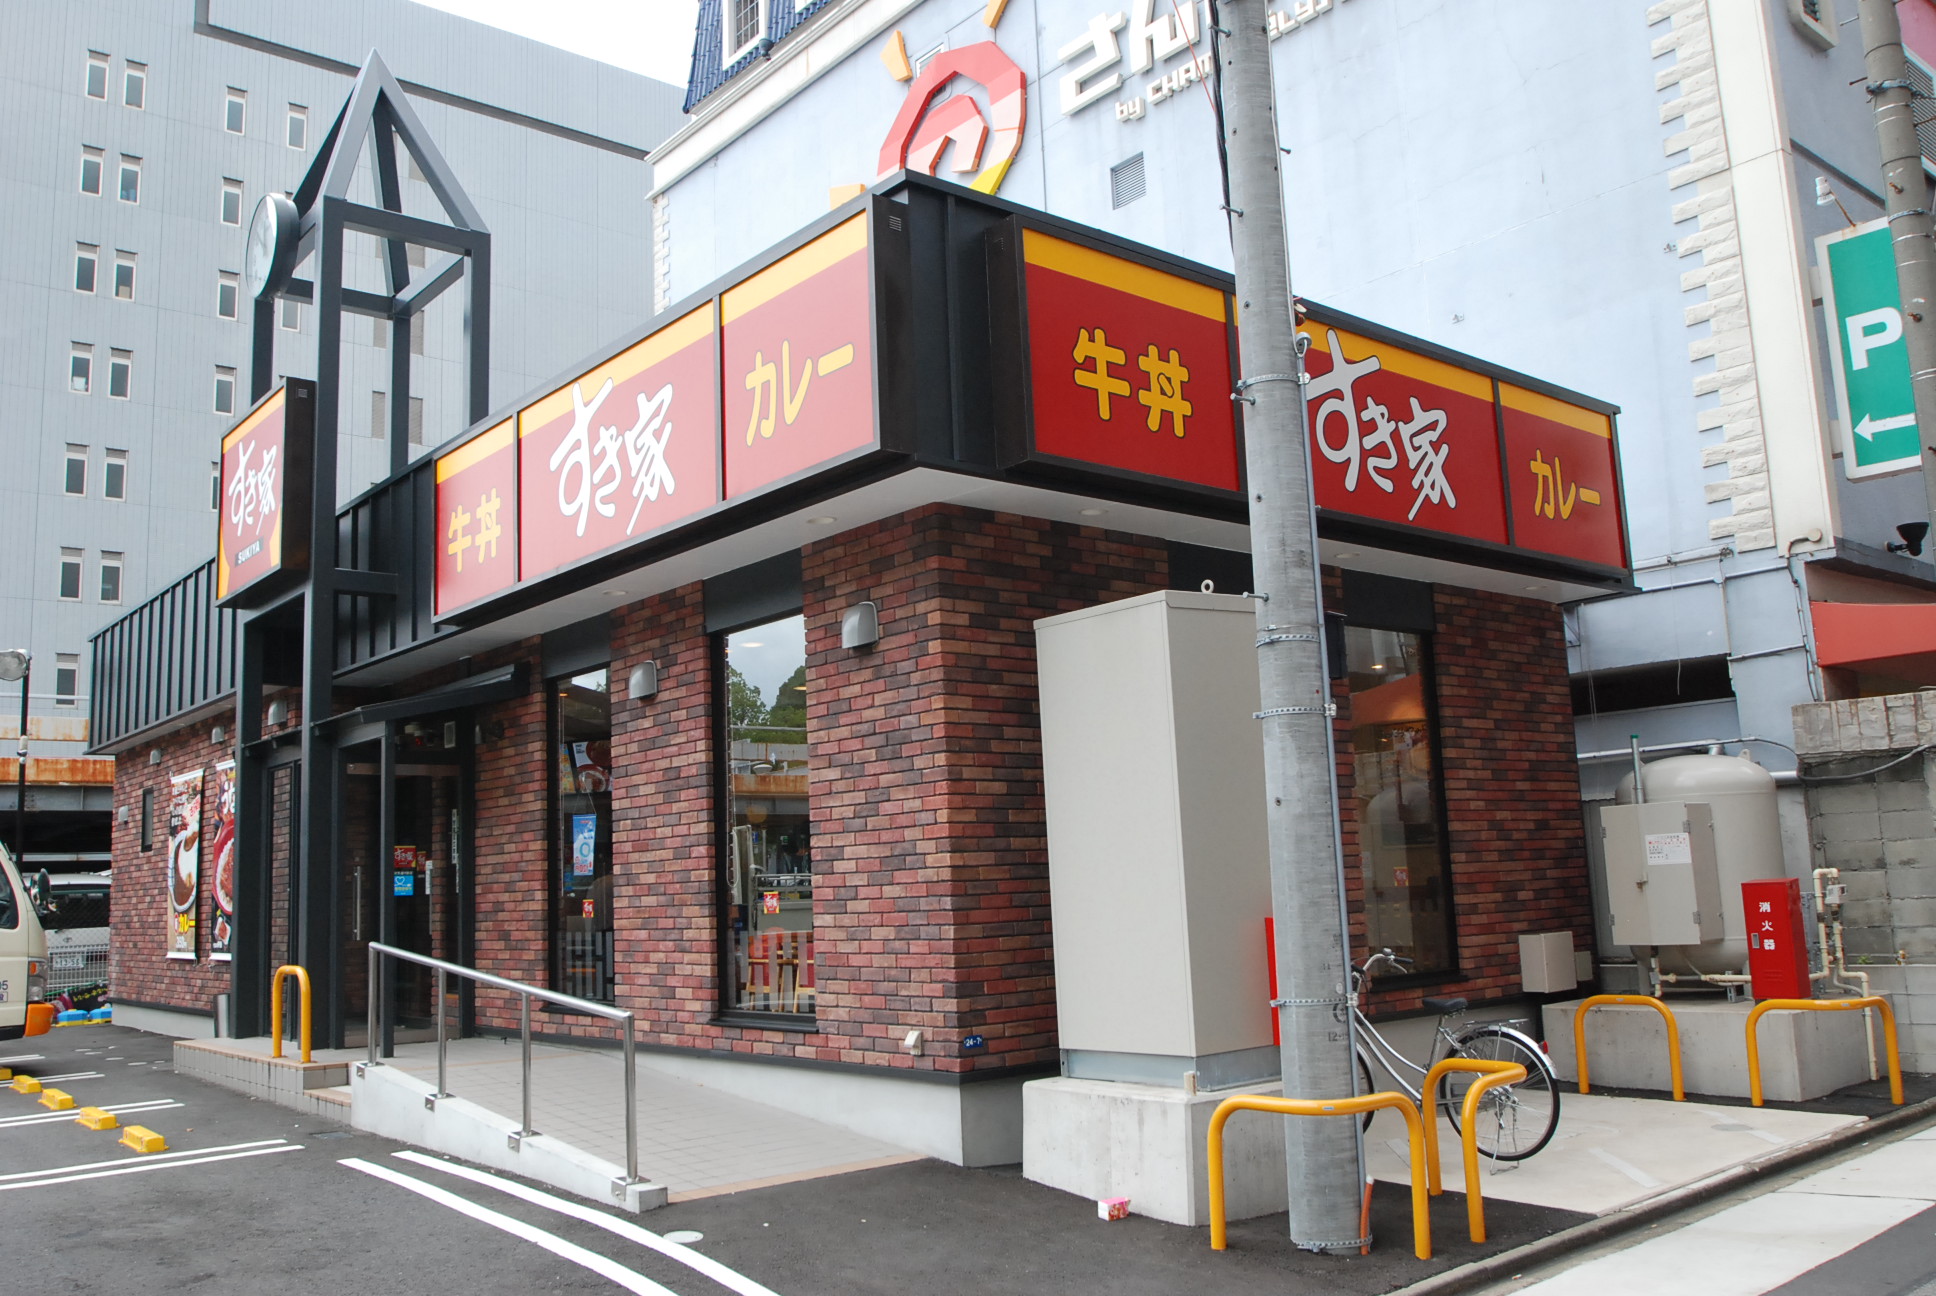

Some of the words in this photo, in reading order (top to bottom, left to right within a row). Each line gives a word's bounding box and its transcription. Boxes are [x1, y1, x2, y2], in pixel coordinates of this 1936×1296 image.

[1058, 0, 1213, 116] さん
[1115, 97, 1145, 122] by
[1147, 52, 1213, 104] CHAM
[1845, 307, 1903, 371] P
[745, 340, 854, 447] カレー
[1072, 326, 1194, 439] 牛丼
[1306, 328, 1456, 522] すき家
[229, 440, 277, 536] すき家
[549, 377, 676, 537] すき家
[1530, 449, 1601, 530] カレー
[238, 541, 260, 564] SUKIYA
[447, 487, 502, 573] 牛丼
[1759, 902, 1775, 950] 消火器
[0, 980, 8, 990] 5
